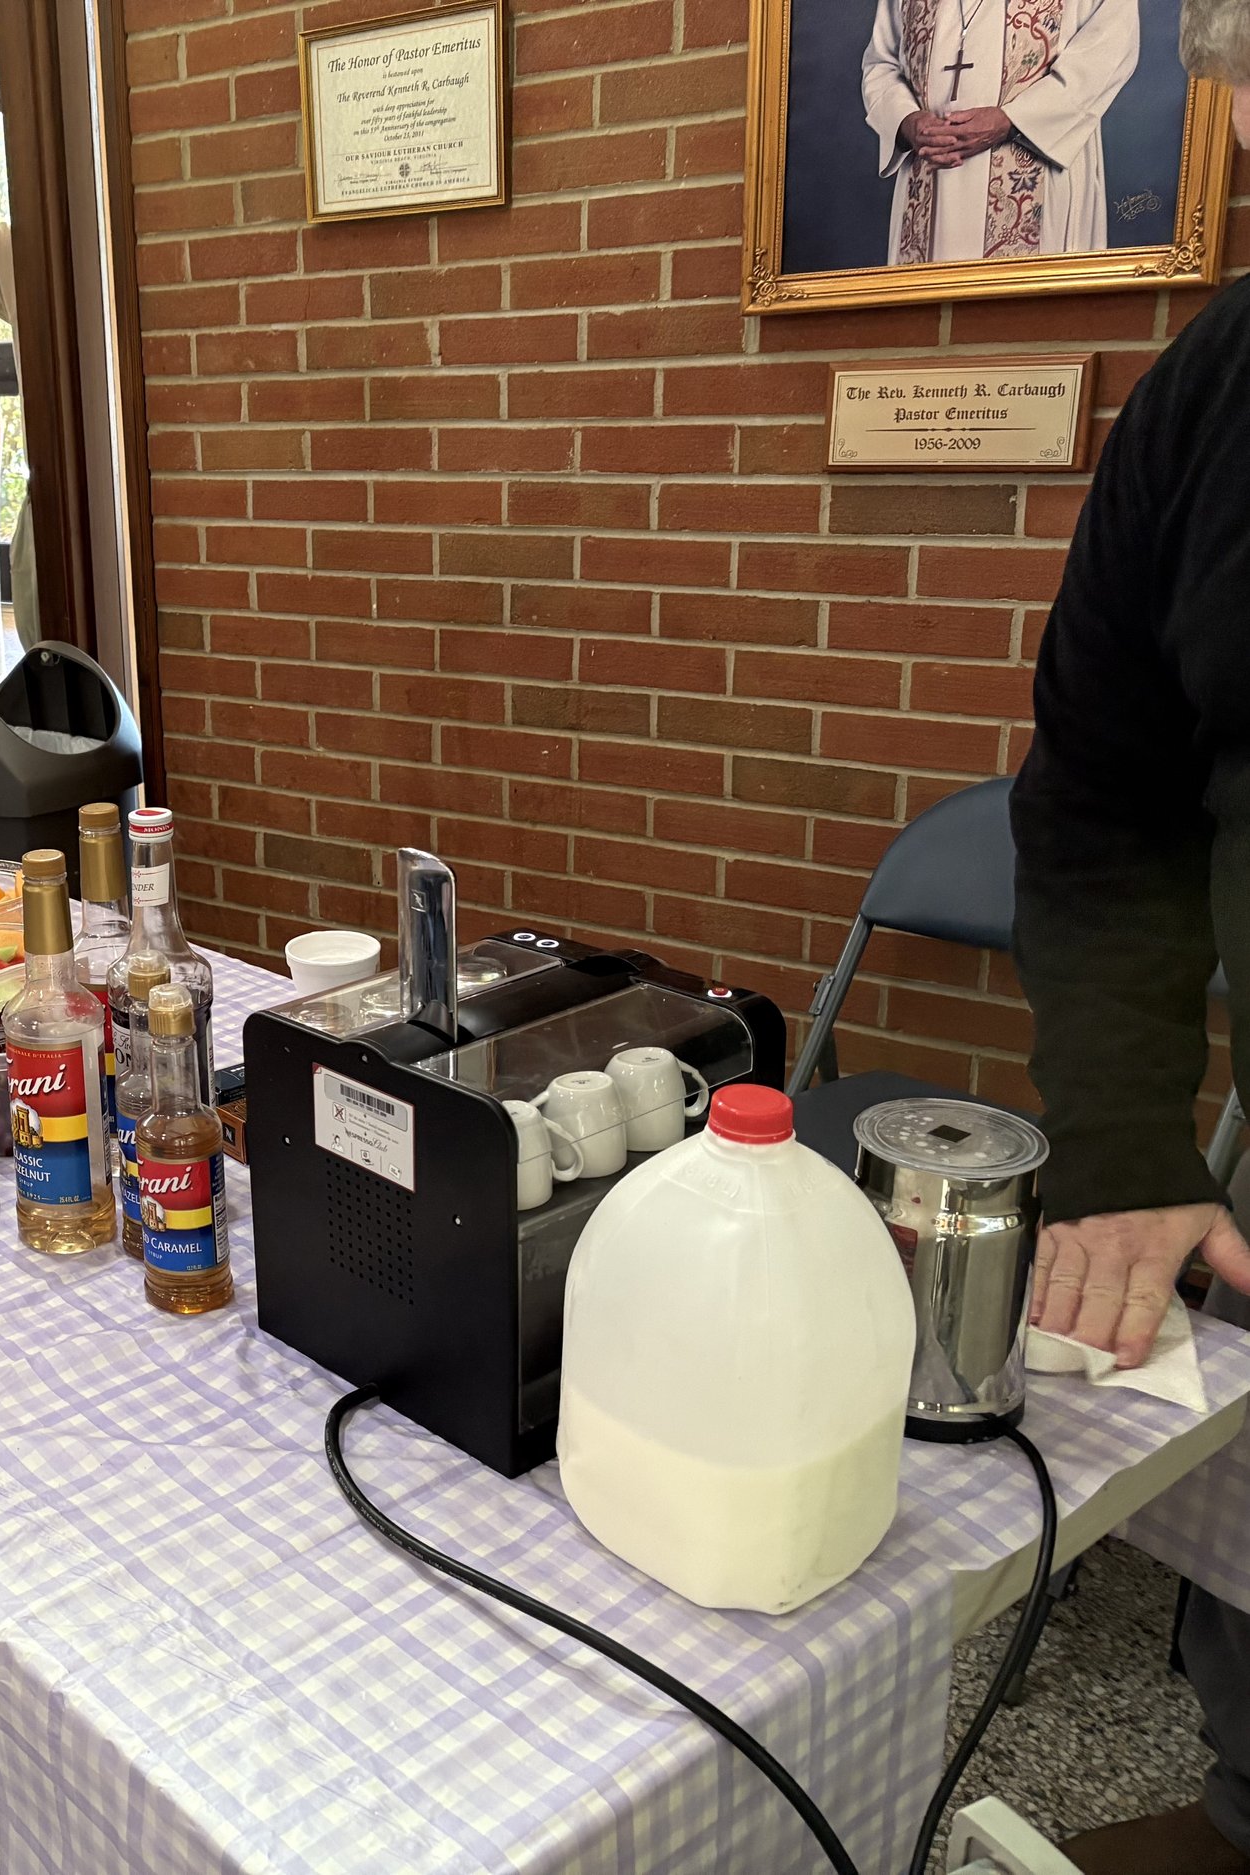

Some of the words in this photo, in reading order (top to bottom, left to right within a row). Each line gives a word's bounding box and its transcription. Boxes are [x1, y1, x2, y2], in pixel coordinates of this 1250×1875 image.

[328, 57, 346, 73] The
[348, 55, 381, 70] Honor
[382, 48, 395, 68] of
[395, 46, 431, 62] Pastor
[431, 37, 481, 55] Emeritus
[336, 91, 350, 103] The
[352, 85, 387, 102] Reverend
[387, 80, 420, 97] Kenneth
[432, 72, 470, 90] Carbaugh
[383, 132, 403, 143] October
[345, 154, 360, 162] OUR
[361, 151, 392, 160] SAVIOUR
[393, 145, 432, 156] LUTHERAN
[433, 140, 464, 151] CHURCH
[846, 386, 871, 401] The
[876, 385, 906, 400] Rev.
[912, 383, 968, 400] Kenneth
[973, 382, 991, 397] R.
[997, 382, 1066, 399] Carbaugh
[893, 406, 940, 424] Pastor
[945, 406, 1009, 421] Emeritus
[914, 437, 981, 450] 1956-2009
[143, 825, 170, 834] MONIN
[131, 883, 155, 892] NDER
[6, 1063, 67, 1096] rani
[15, 1162, 51, 1182] AZELNUT
[138, 1165, 192, 1194] rani
[150, 1237, 202, 1254] CARAMEL
